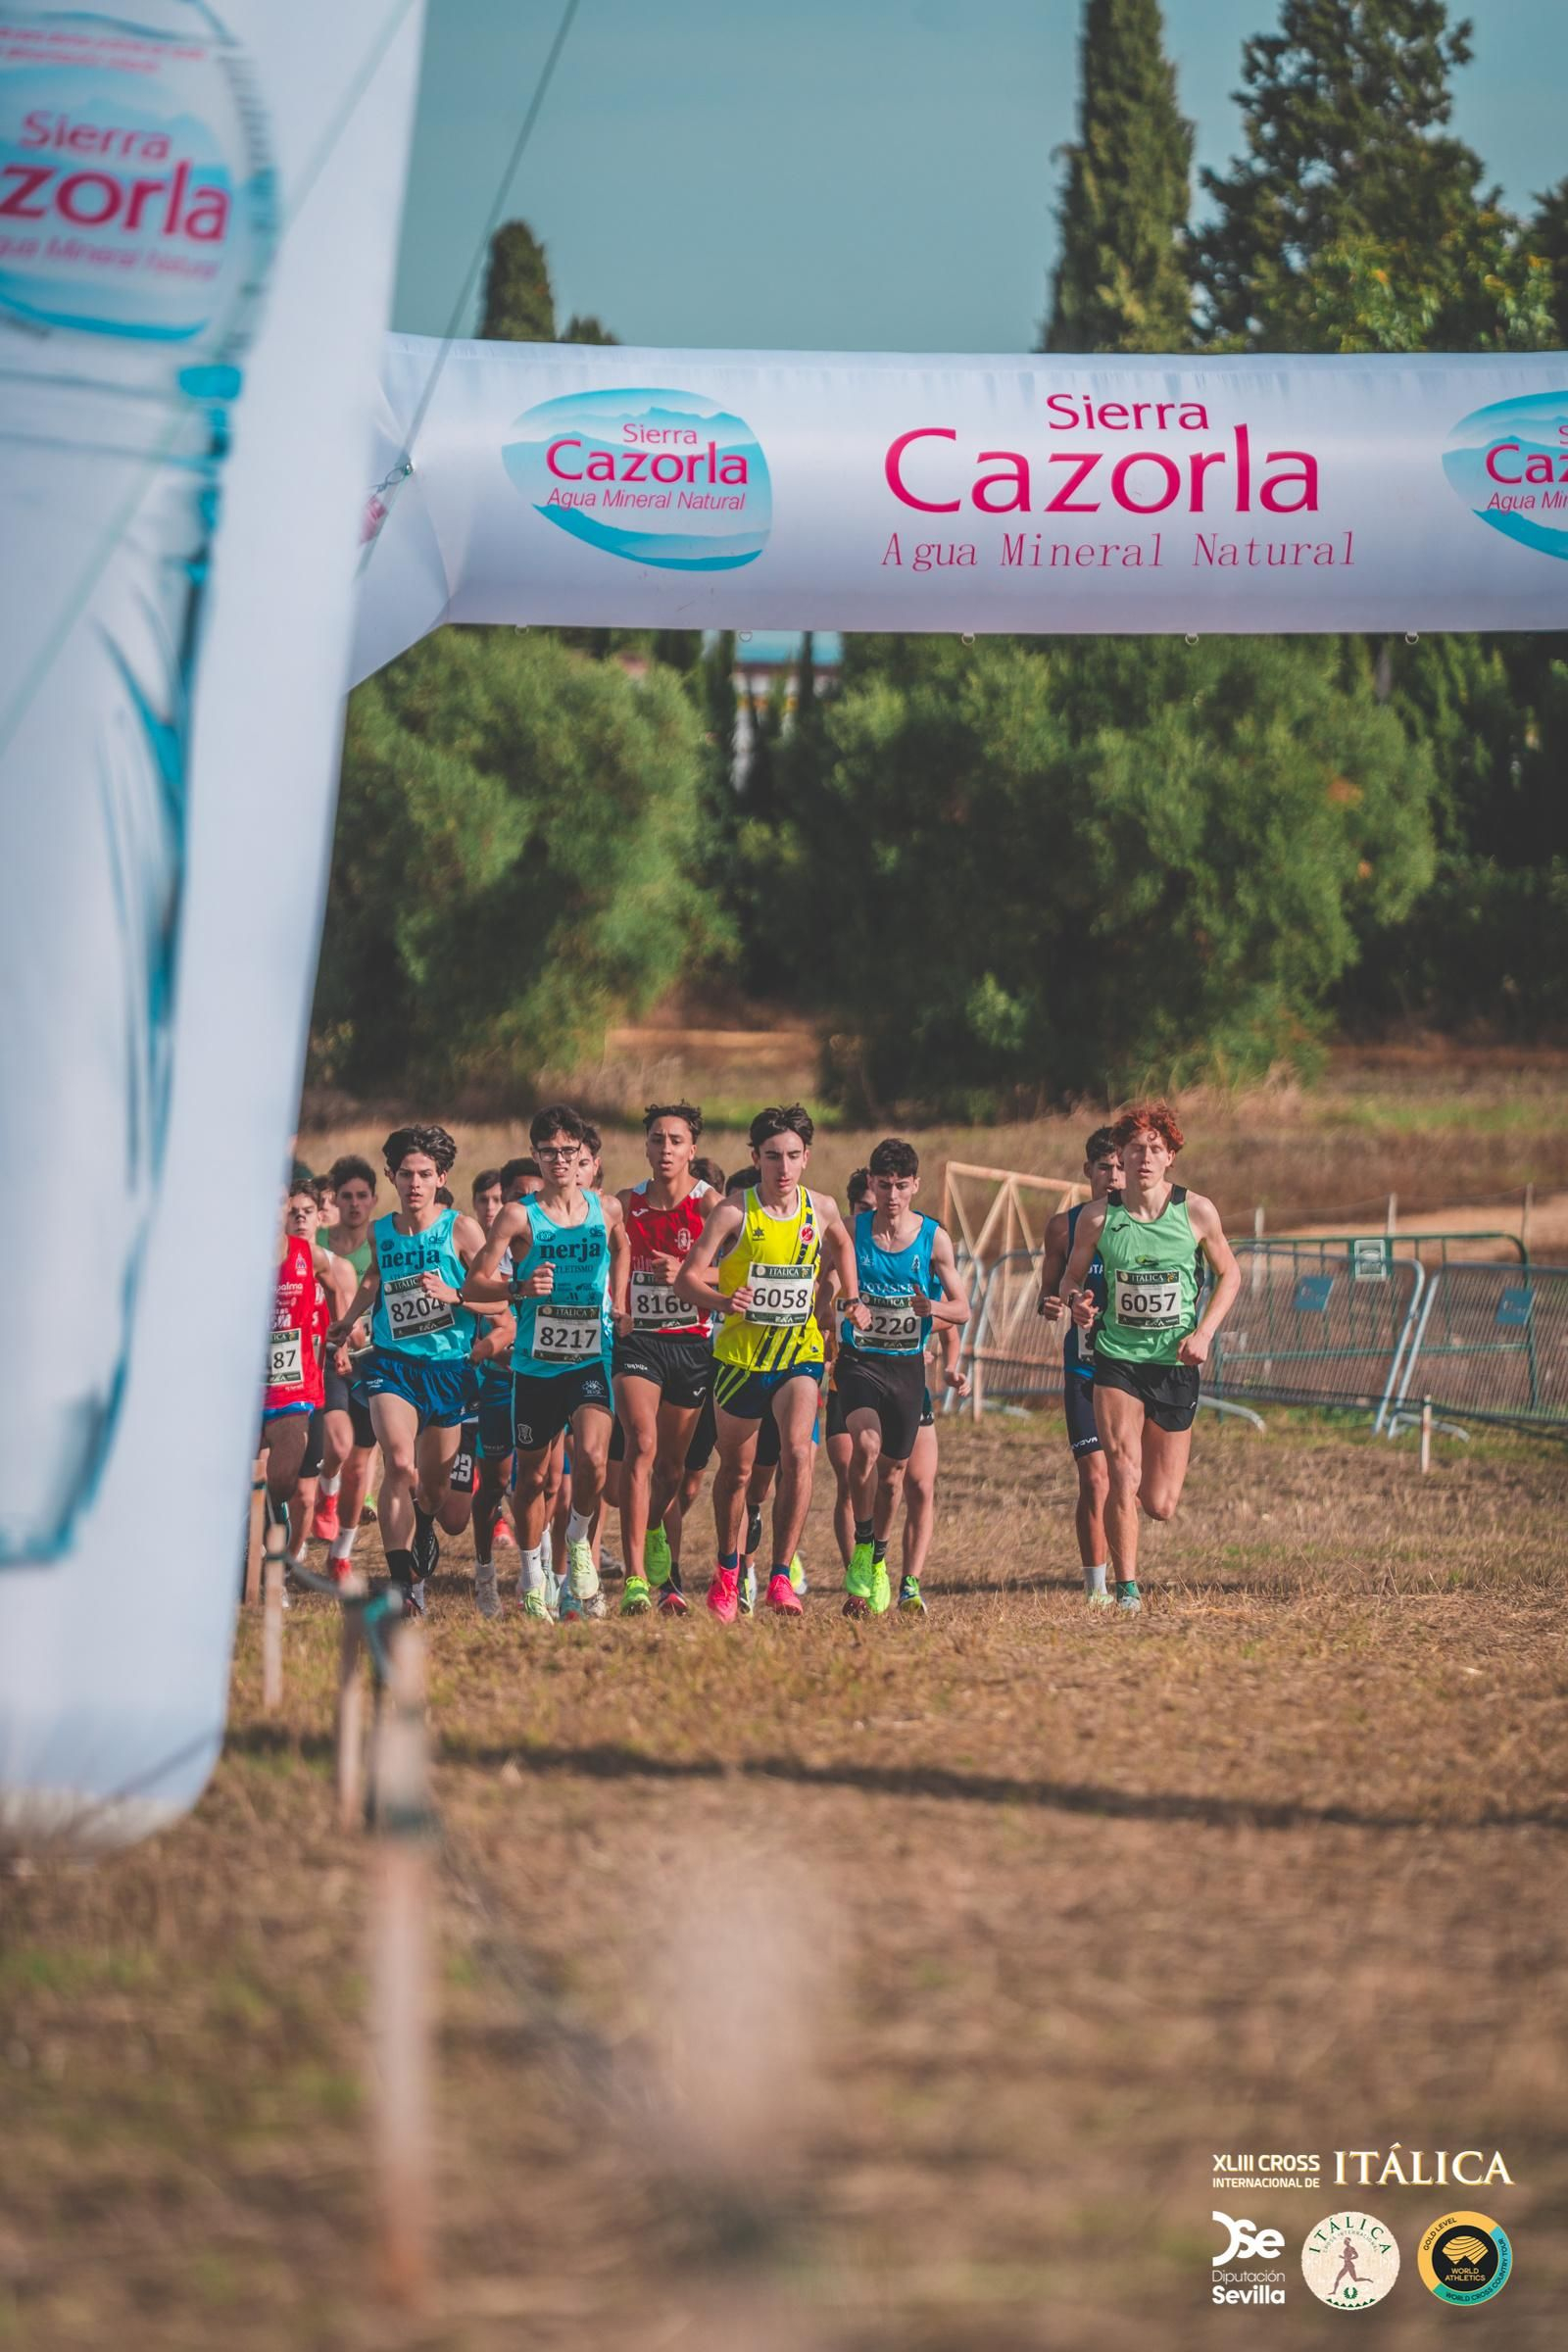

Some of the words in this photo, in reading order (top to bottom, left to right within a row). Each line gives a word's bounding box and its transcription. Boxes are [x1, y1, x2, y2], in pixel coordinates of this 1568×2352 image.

[19, 110, 172, 161] Sierra
[1047, 394, 1209, 429] Sierra
[622, 423, 698, 444] Sierra
[546, 439, 748, 485] Cazorla
[885, 422, 1319, 514] Cazorla
[546, 487, 596, 512] Agua
[602, 489, 672, 509] Mineral
[677, 491, 746, 511] Natural
[1488, 491, 1536, 514] Agua
[881, 531, 977, 571] Agua
[999, 532, 1164, 567] Mineral
[1192, 530, 1356, 566] Natural
[382, 1245, 440, 1270] nerja
[540, 1238, 601, 1262] nerja
[394, 1277, 419, 1291] ITALIC
[391, 1298, 444, 1322] 8204
[753, 1288, 808, 1308] 6058
[1120, 1293, 1176, 1313] 6057
[540, 1327, 597, 1348] 8217
